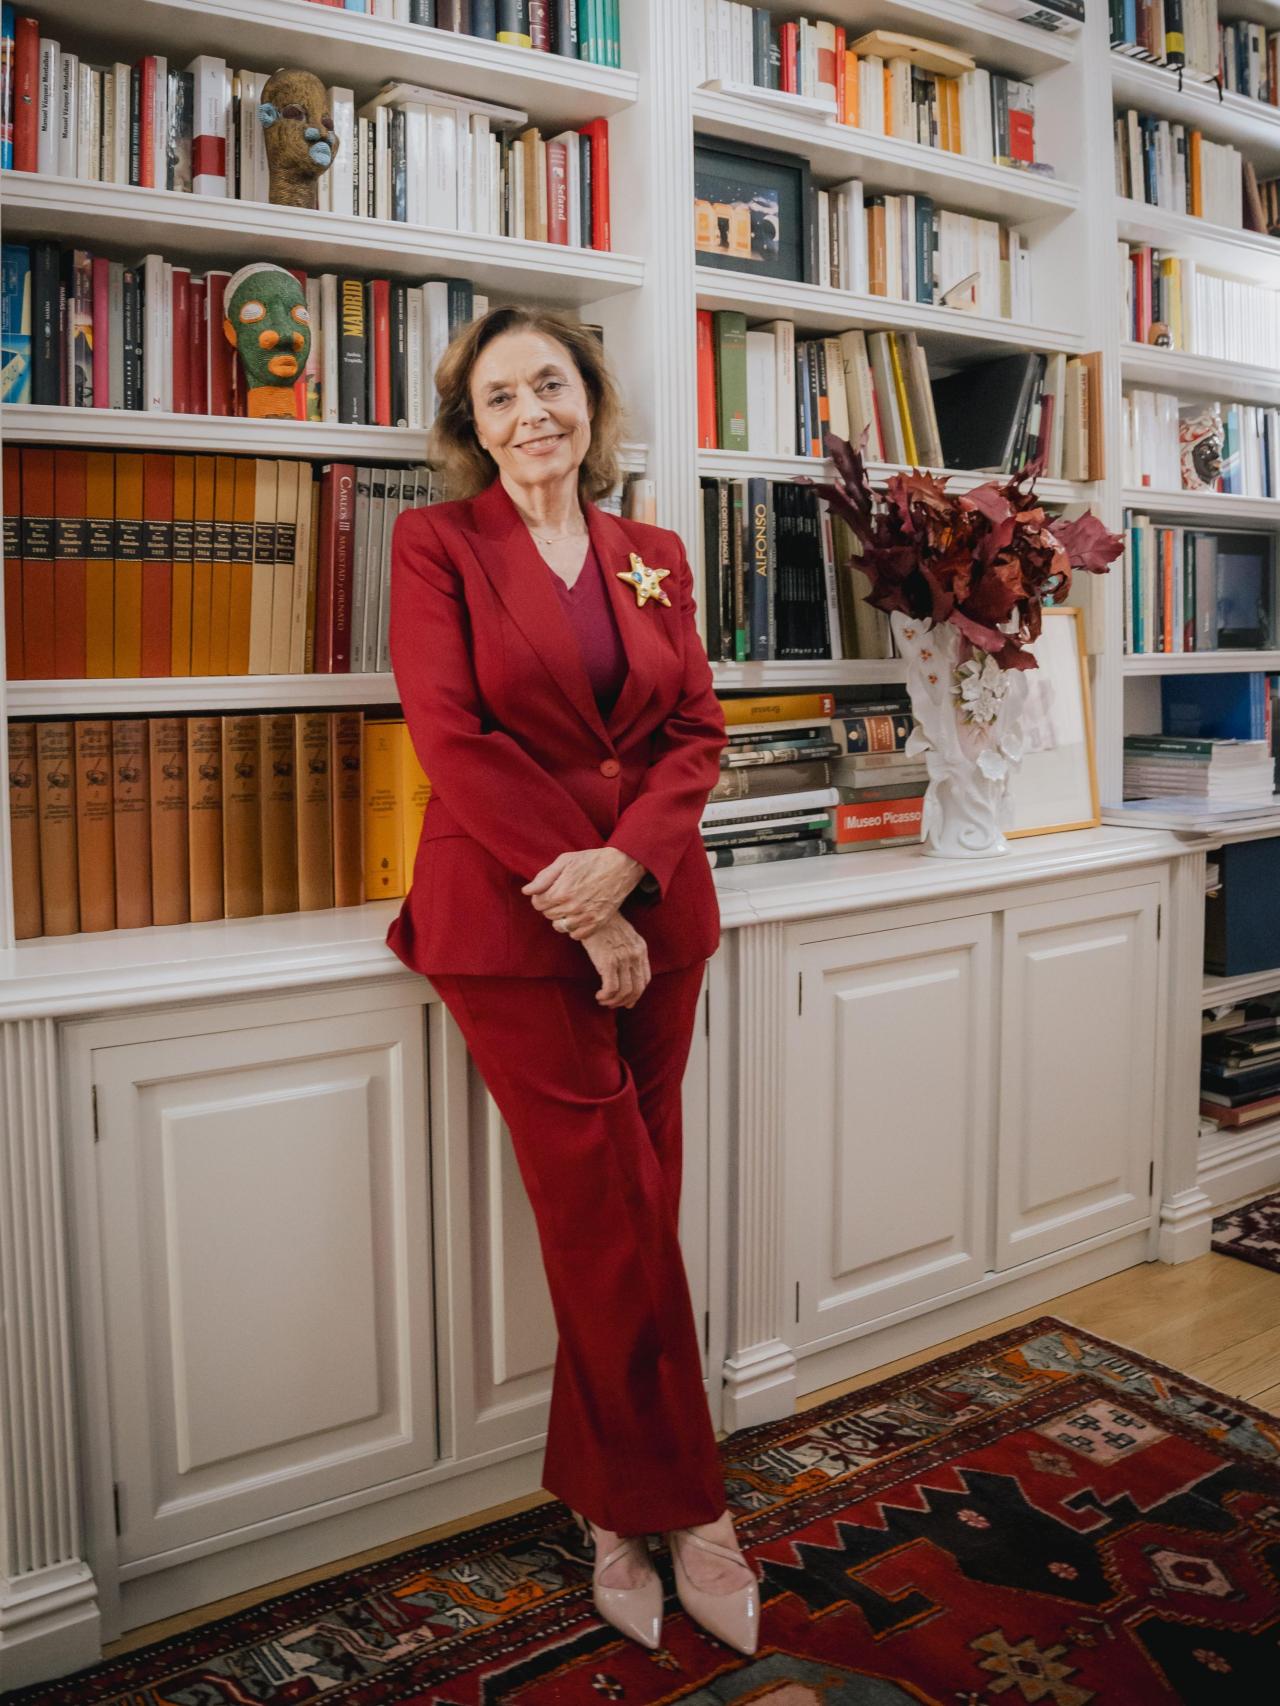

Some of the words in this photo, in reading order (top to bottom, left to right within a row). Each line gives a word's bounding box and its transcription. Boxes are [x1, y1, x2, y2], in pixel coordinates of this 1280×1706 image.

[41, 51, 49, 83] Montalbán
[62, 59, 70, 91] Montalbán
[41, 84, 50, 108] Vázquez
[62, 91, 70, 116] Vázquez
[557, 183, 566, 221] Sefarad
[343, 280, 364, 338] MADRID
[338, 476, 353, 521] CARLOS
[338, 521, 352, 531] III
[754, 503, 768, 577] ALFONSO
[337, 535, 347, 582] MAJESTAD
[337, 589, 345, 631] ORNATO
[846, 814, 882, 830] Museo
[882, 811, 921, 826] Picasso
